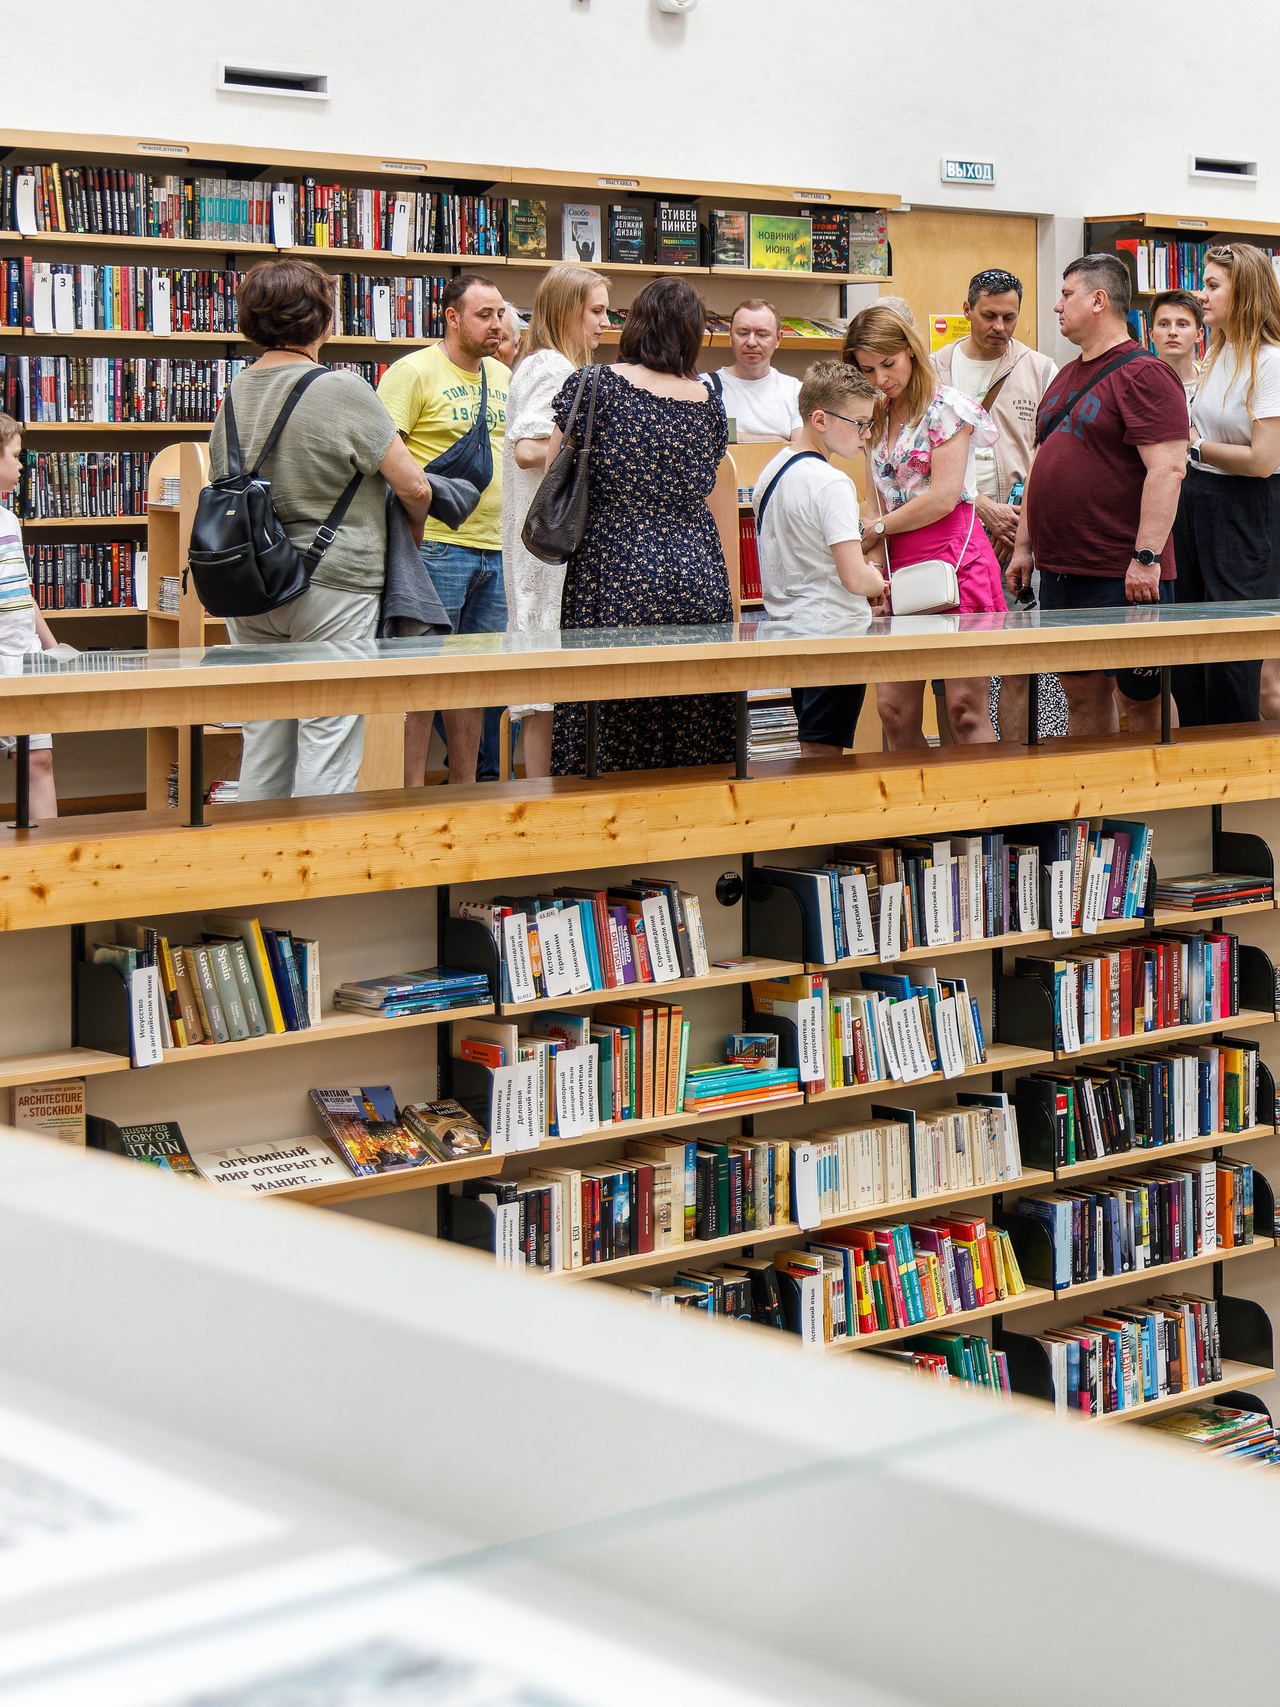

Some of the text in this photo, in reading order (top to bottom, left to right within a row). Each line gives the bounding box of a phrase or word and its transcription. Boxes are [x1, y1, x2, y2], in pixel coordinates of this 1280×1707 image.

[606, 179, 632, 187] ВЫСТАВКА
[946, 162, 992, 180] ВЫХОД
[661, 209, 697, 221] СТИВЕН
[661, 220, 698, 232] ПИНКЕР
[616, 228, 642, 237] ДИЗАЙН
[758, 231, 797, 241] НОВИНКИ
[765, 245, 790, 254] ИЮНЯ
[158, 281, 166, 291] К
[442, 386, 468, 400] TOM
[470, 385, 507, 402] TALOR
[452, 407, 469, 420] 19
[1086, 874, 1095, 919] Разговорный
[852, 904, 864, 941] Греческий
[611, 931, 620, 971] DEUTSCH
[649, 915, 664, 968] Страноведение
[660, 927, 672, 963] немецком
[173, 950, 185, 978] Italy
[217, 948, 231, 981] Spain
[235, 944, 249, 985] France
[510, 935, 521, 987] Нидерландский
[518, 940, 529, 987] (голландский)
[544, 940, 554, 976] История
[553, 933, 564, 976] Германии
[569, 938, 580, 978] Немецкий
[199, 951, 213, 990] Greece
[668, 964, 674, 973] на
[148, 1000, 156, 1047] английском
[152, 1048, 157, 1059] на
[897, 1021, 908, 1066] Разговорники
[907, 1029, 918, 1073] французского
[18, 1093, 82, 1106] ARCHITECTURE
[29, 1105, 82, 1117] STOCKHOLM
[431, 1102, 457, 1111] Britain
[436, 1107, 462, 1115] Ireland
[122, 1125, 168, 1135] LLUSTRATED
[156, 1131, 171, 1140] OF
[218, 1145, 310, 1169] ОГРОМНЫЙ
[803, 1154, 809, 1162] D
[215, 1156, 335, 1183] МИР ОТКРЫТ И
[1205, 1171, 1215, 1245] HERODES
